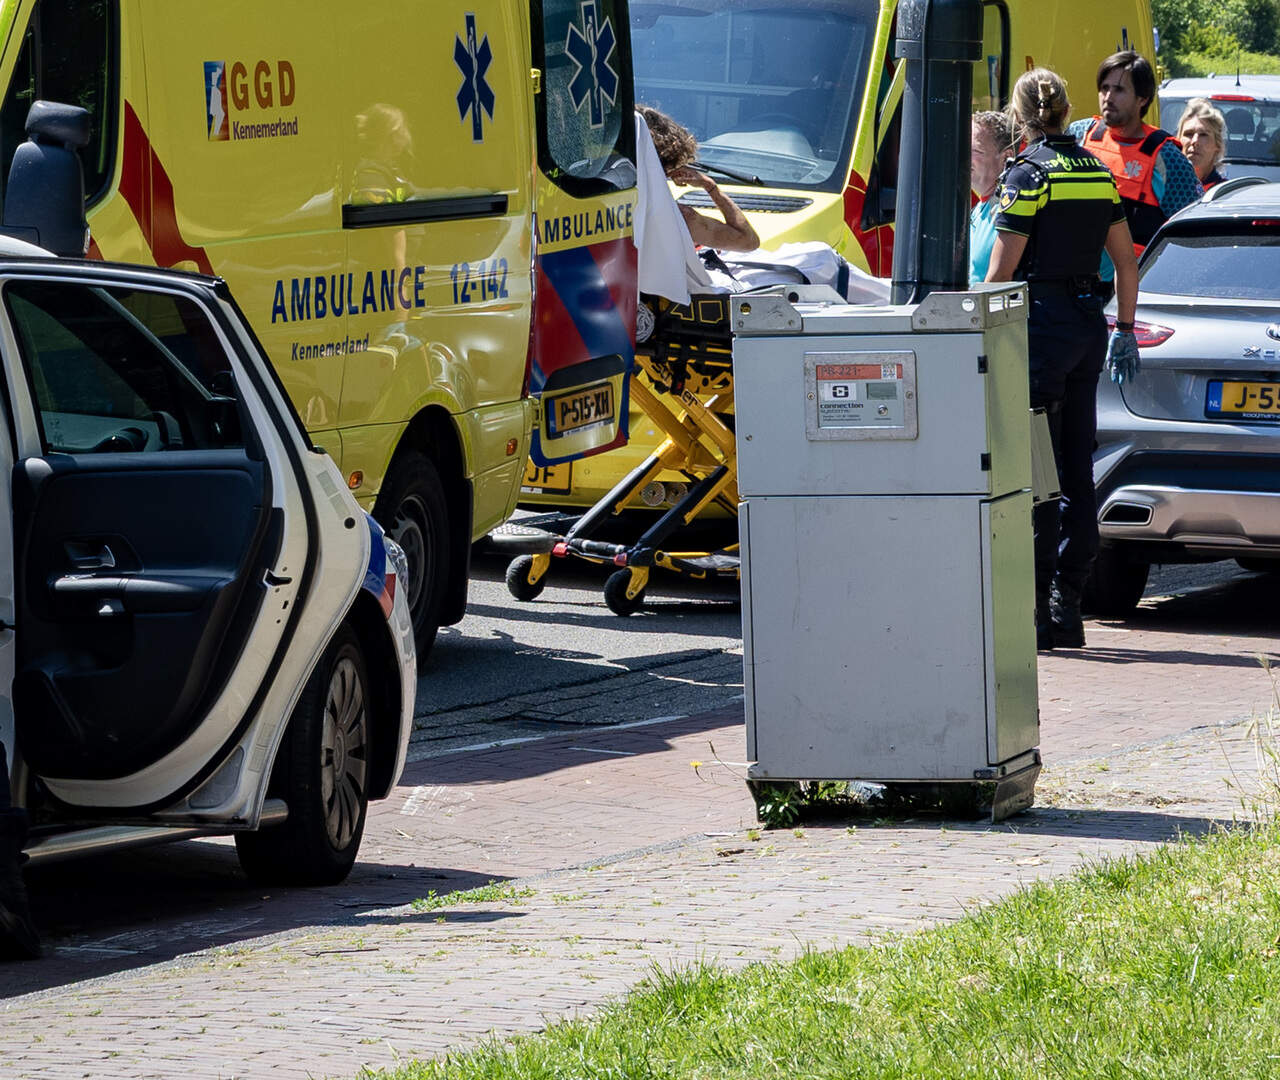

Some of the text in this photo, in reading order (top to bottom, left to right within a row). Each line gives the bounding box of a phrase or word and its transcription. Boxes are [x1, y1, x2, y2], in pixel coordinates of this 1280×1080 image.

[230, 60, 296, 111] GGD
[232, 117, 298, 141] Kennemerland
[271, 257, 509, 324] AMBULANCE 12-142
[291, 333, 369, 361] Kennemerland
